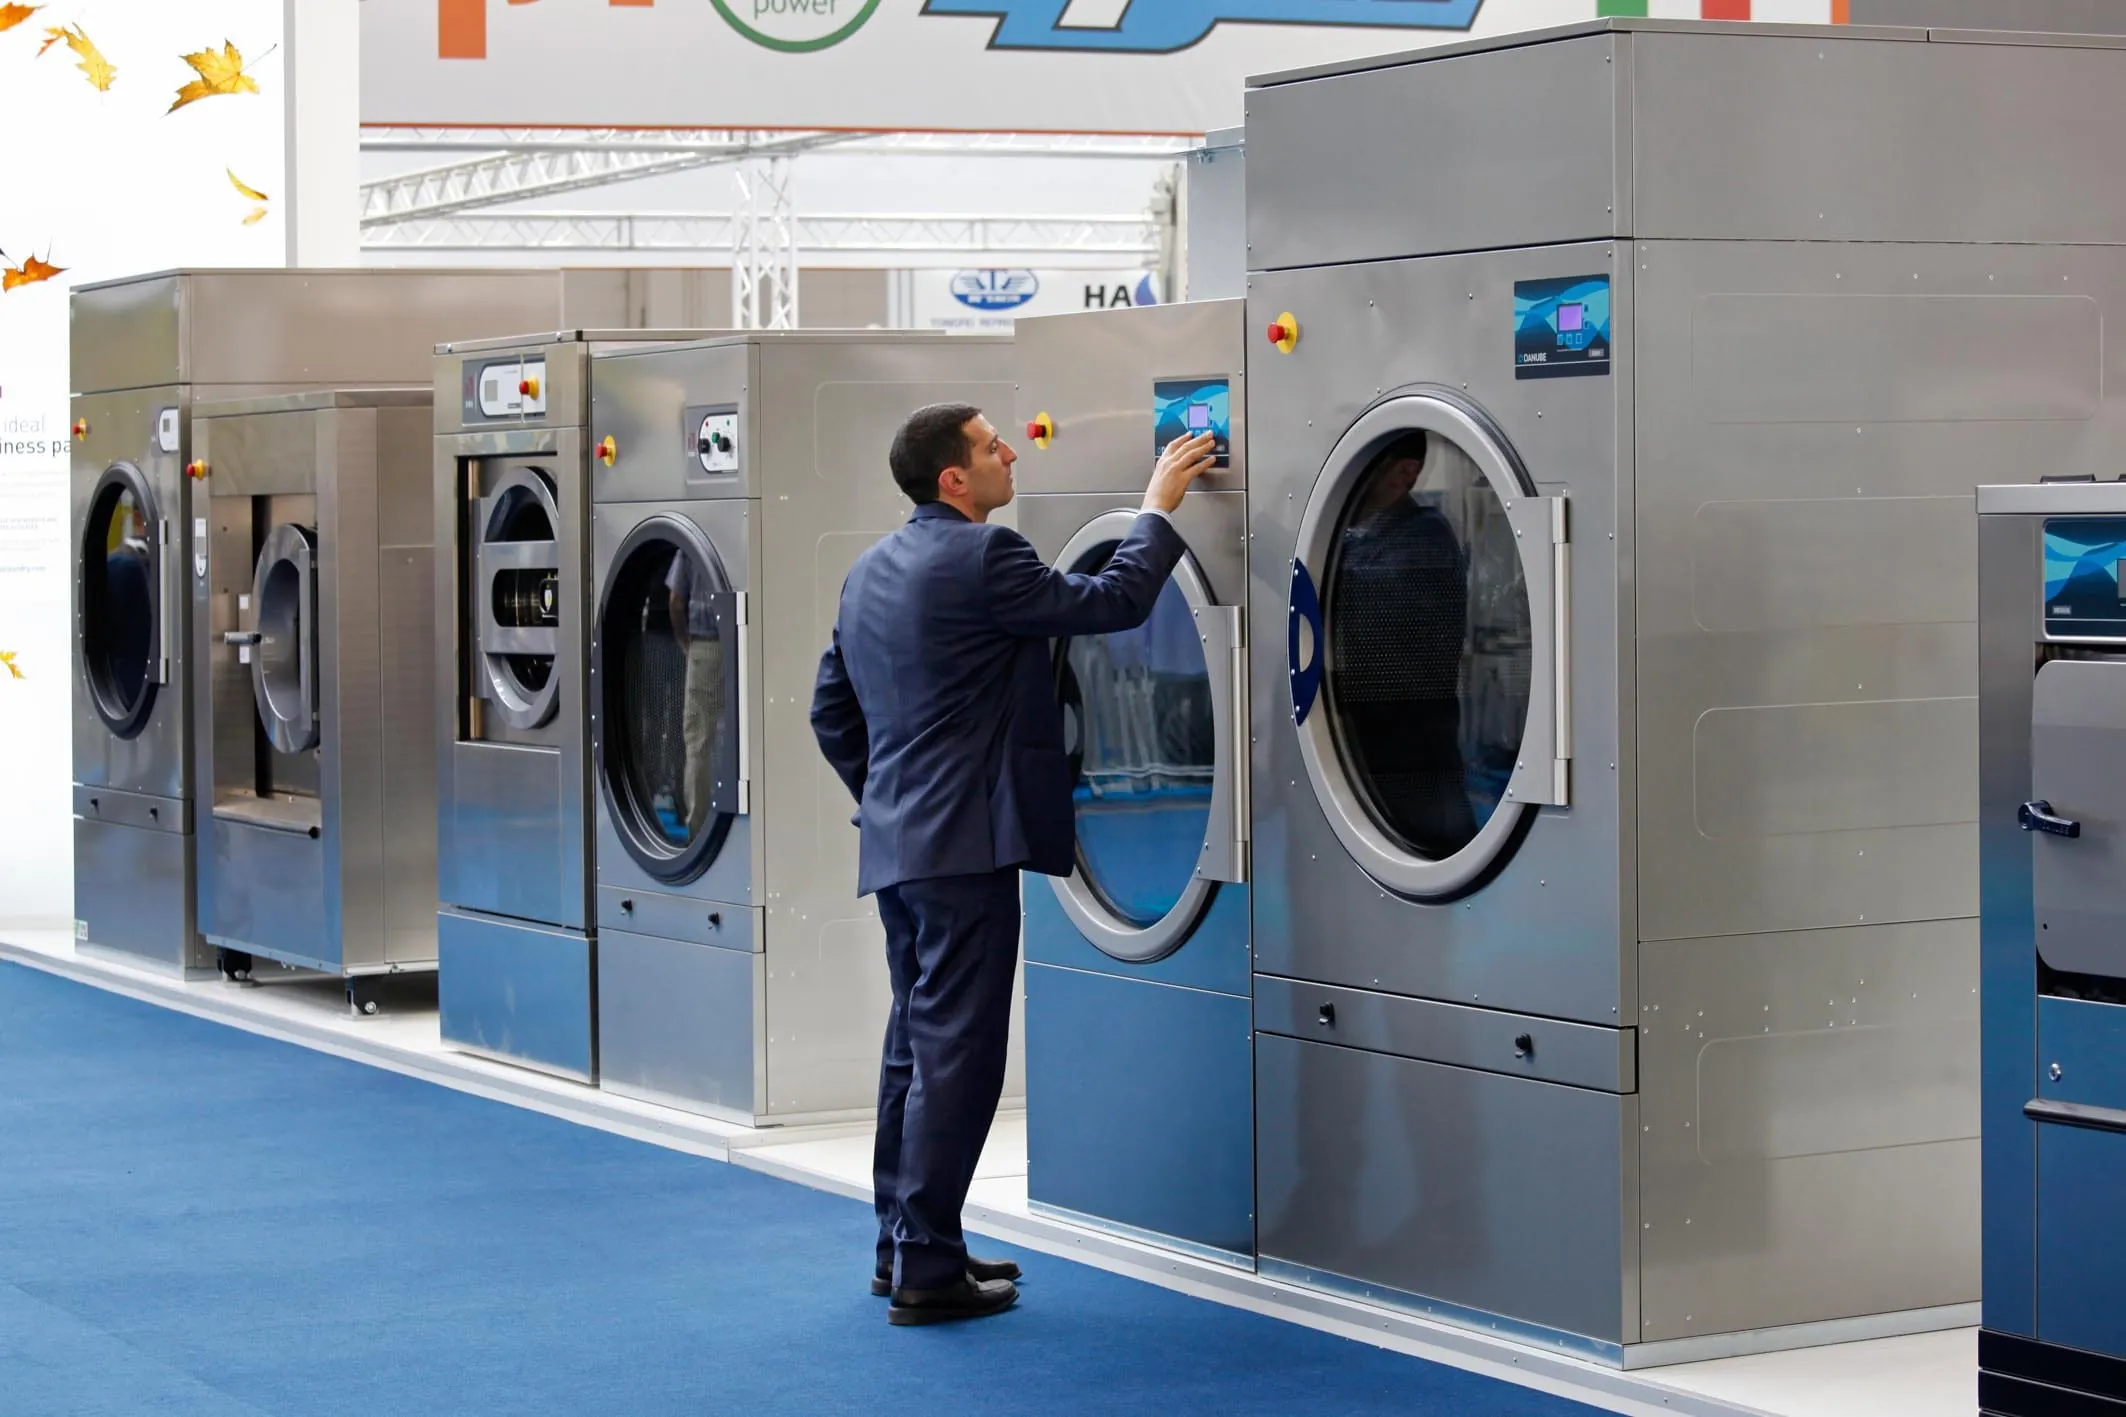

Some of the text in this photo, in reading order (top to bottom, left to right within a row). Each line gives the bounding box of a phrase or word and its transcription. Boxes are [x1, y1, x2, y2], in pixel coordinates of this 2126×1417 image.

[753, 0, 836, 20] power
[1523, 352, 1547, 362] DANUBE
[4, 413, 45, 433] ideal
